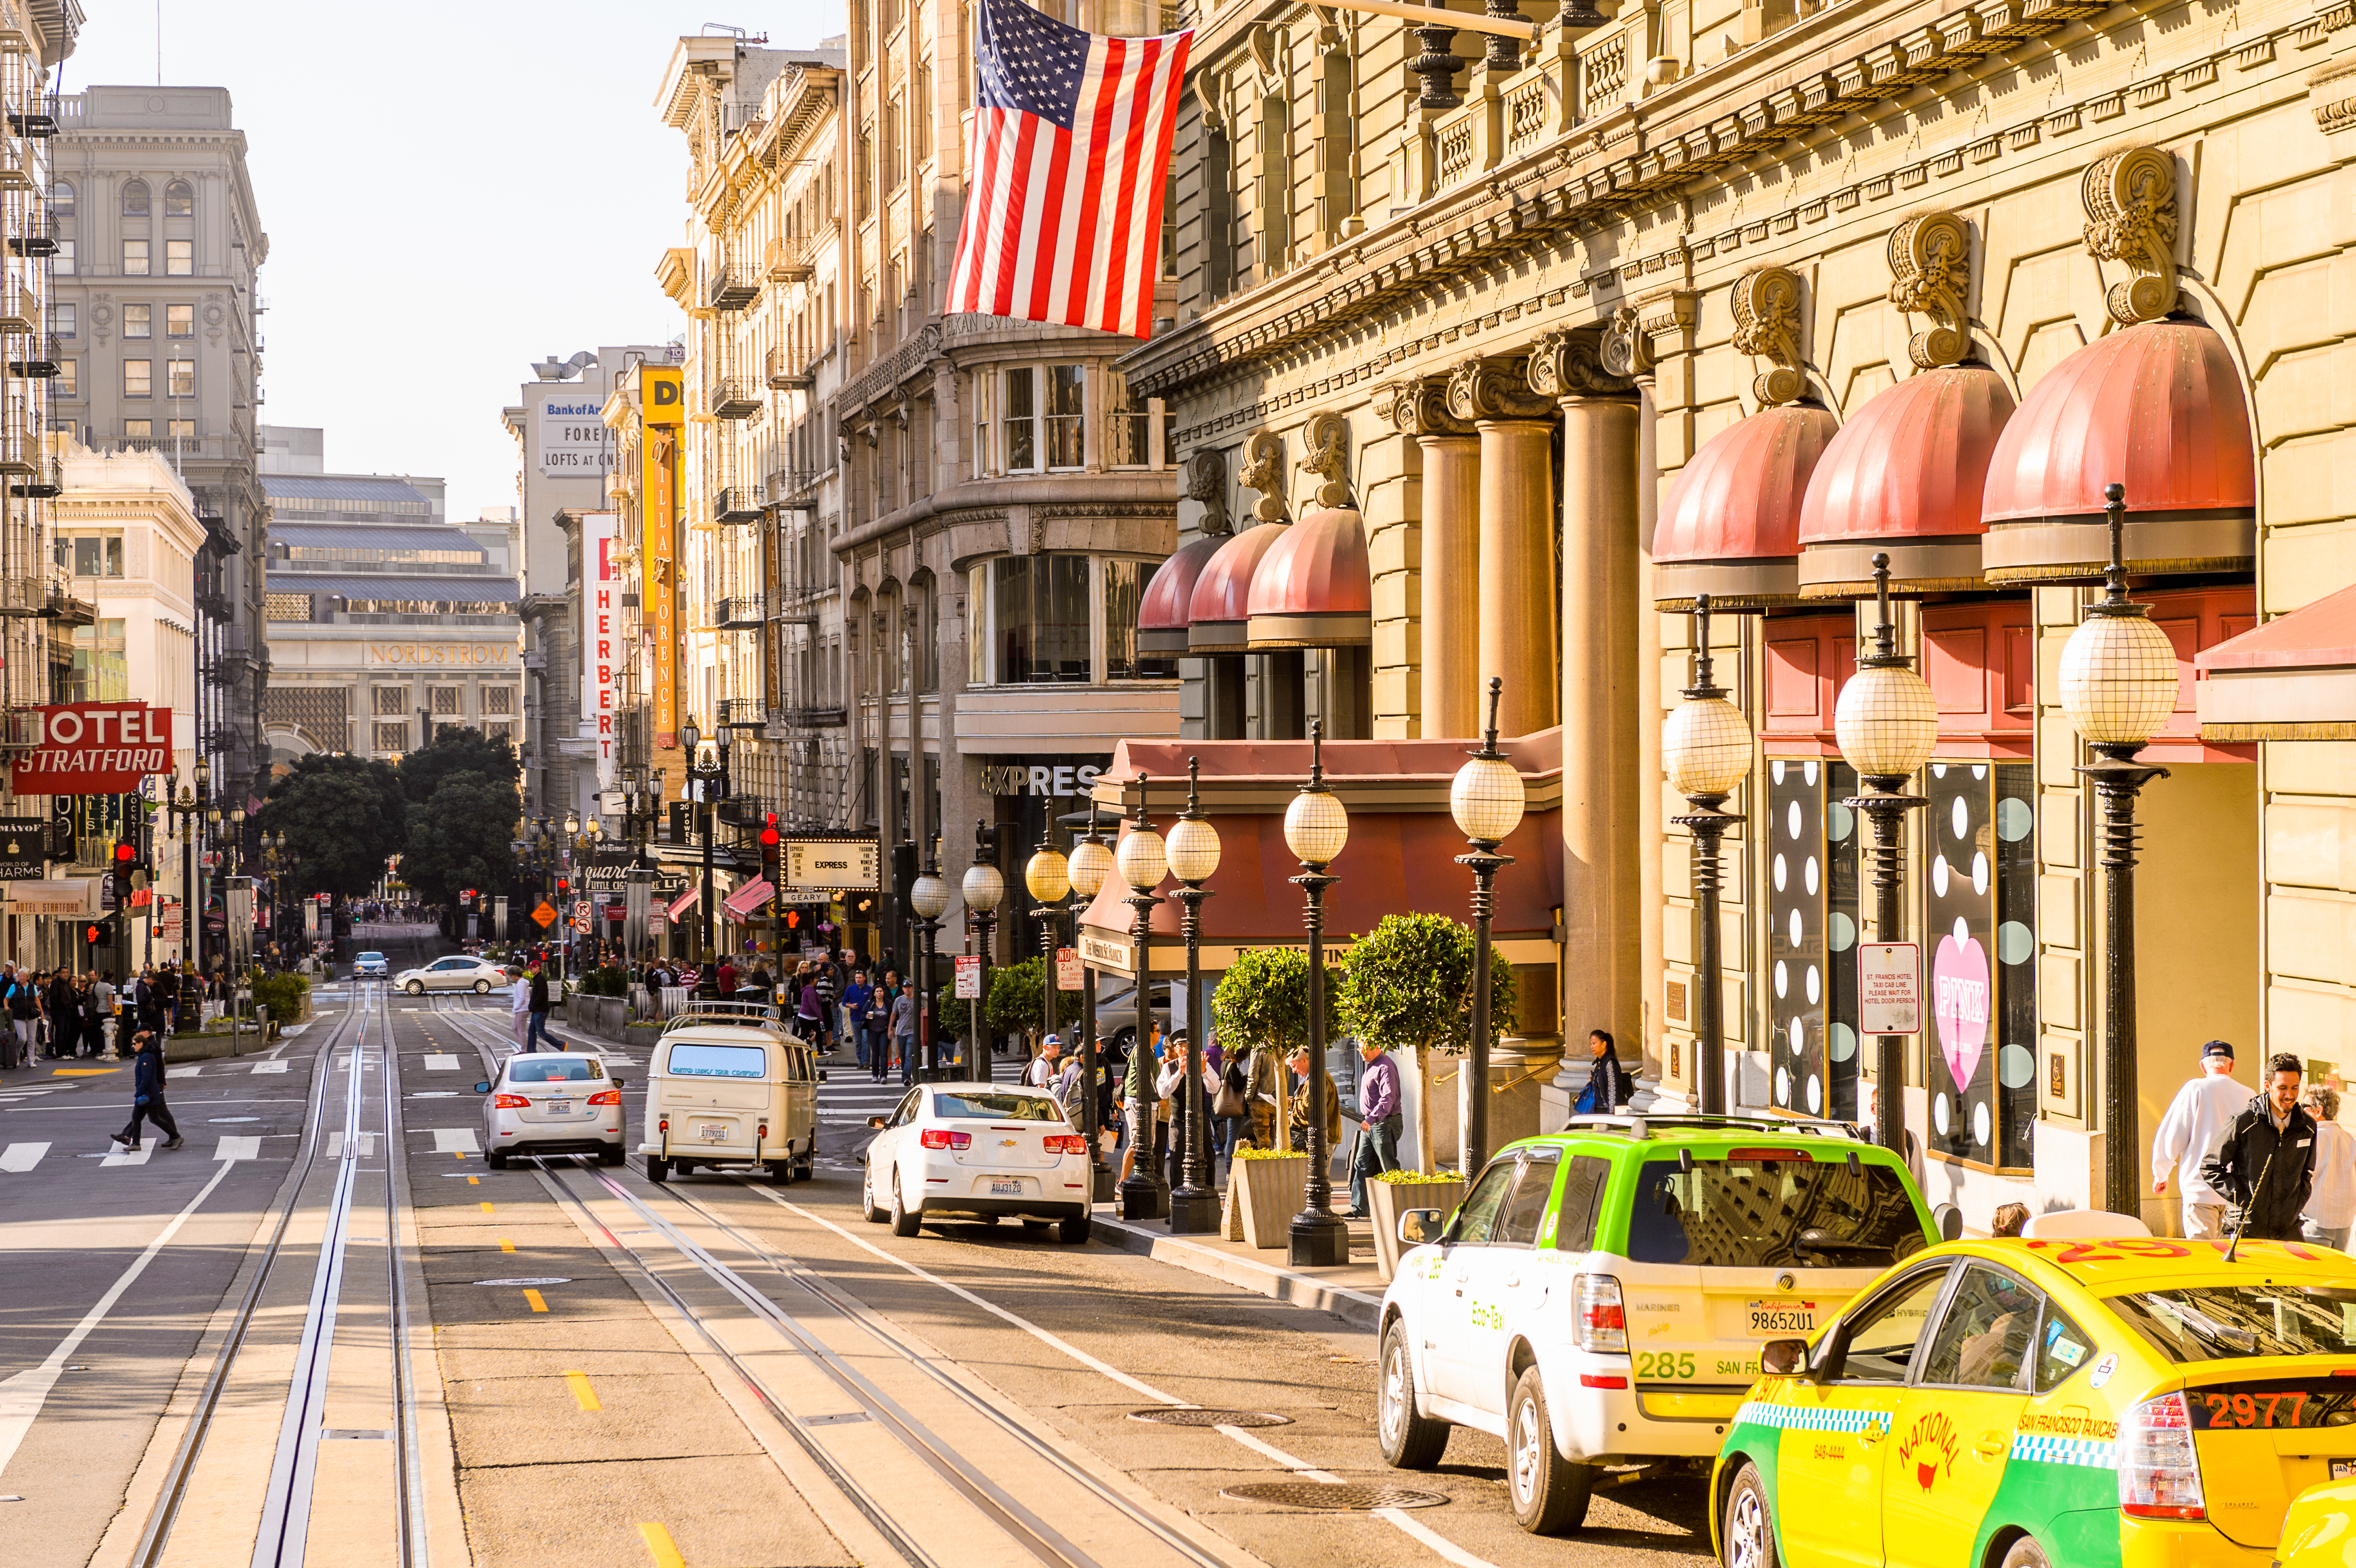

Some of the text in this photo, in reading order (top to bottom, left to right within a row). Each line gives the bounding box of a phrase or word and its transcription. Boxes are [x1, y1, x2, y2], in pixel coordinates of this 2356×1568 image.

[947, 314, 978, 337] ELKAN
[548, 405, 574, 415] Bank
[576, 404, 587, 415] of
[546, 454, 578, 466] LOFTS
[583, 456, 593, 466] AT
[652, 438, 675, 551] VILLA
[652, 555, 672, 724] FLORENCE
[371, 646, 508, 663] NORDSTROM
[598, 591, 611, 759] HERBERT
[19, 749, 164, 773] STRATFORD
[977, 765, 1113, 796] EXPRES
[591, 881, 610, 889] LITTLE
[16, 903, 78, 913] HOTEL STRATFORD
[1059, 950, 1070, 960] NO
[957, 964, 964, 972] NO
[1939, 975, 1984, 1024] PINK
[1951, 1040, 1973, 1054] FALL 2015
[992, 1183, 1021, 1193] AUJ3120
[1636, 1304, 1680, 1312] MARINER
[1761, 1301, 1805, 1313] California
[1472, 1301, 1505, 1331] Eco-Taxi
[1752, 1312, 1815, 1330] 98652U1
[1638, 1352, 1695, 1379] 285
[1717, 1361, 1763, 1375] SAN FR
[2206, 1392, 2307, 1427] 2977
[2018, 1414, 2120, 1439] SAN FRANCISCO TAXICAB
[1814, 1444, 1844, 1461] 648-4444
[1899, 1412, 1959, 1479] NATIONAL
[2222, 1500, 2260, 1509] TOYOTA
